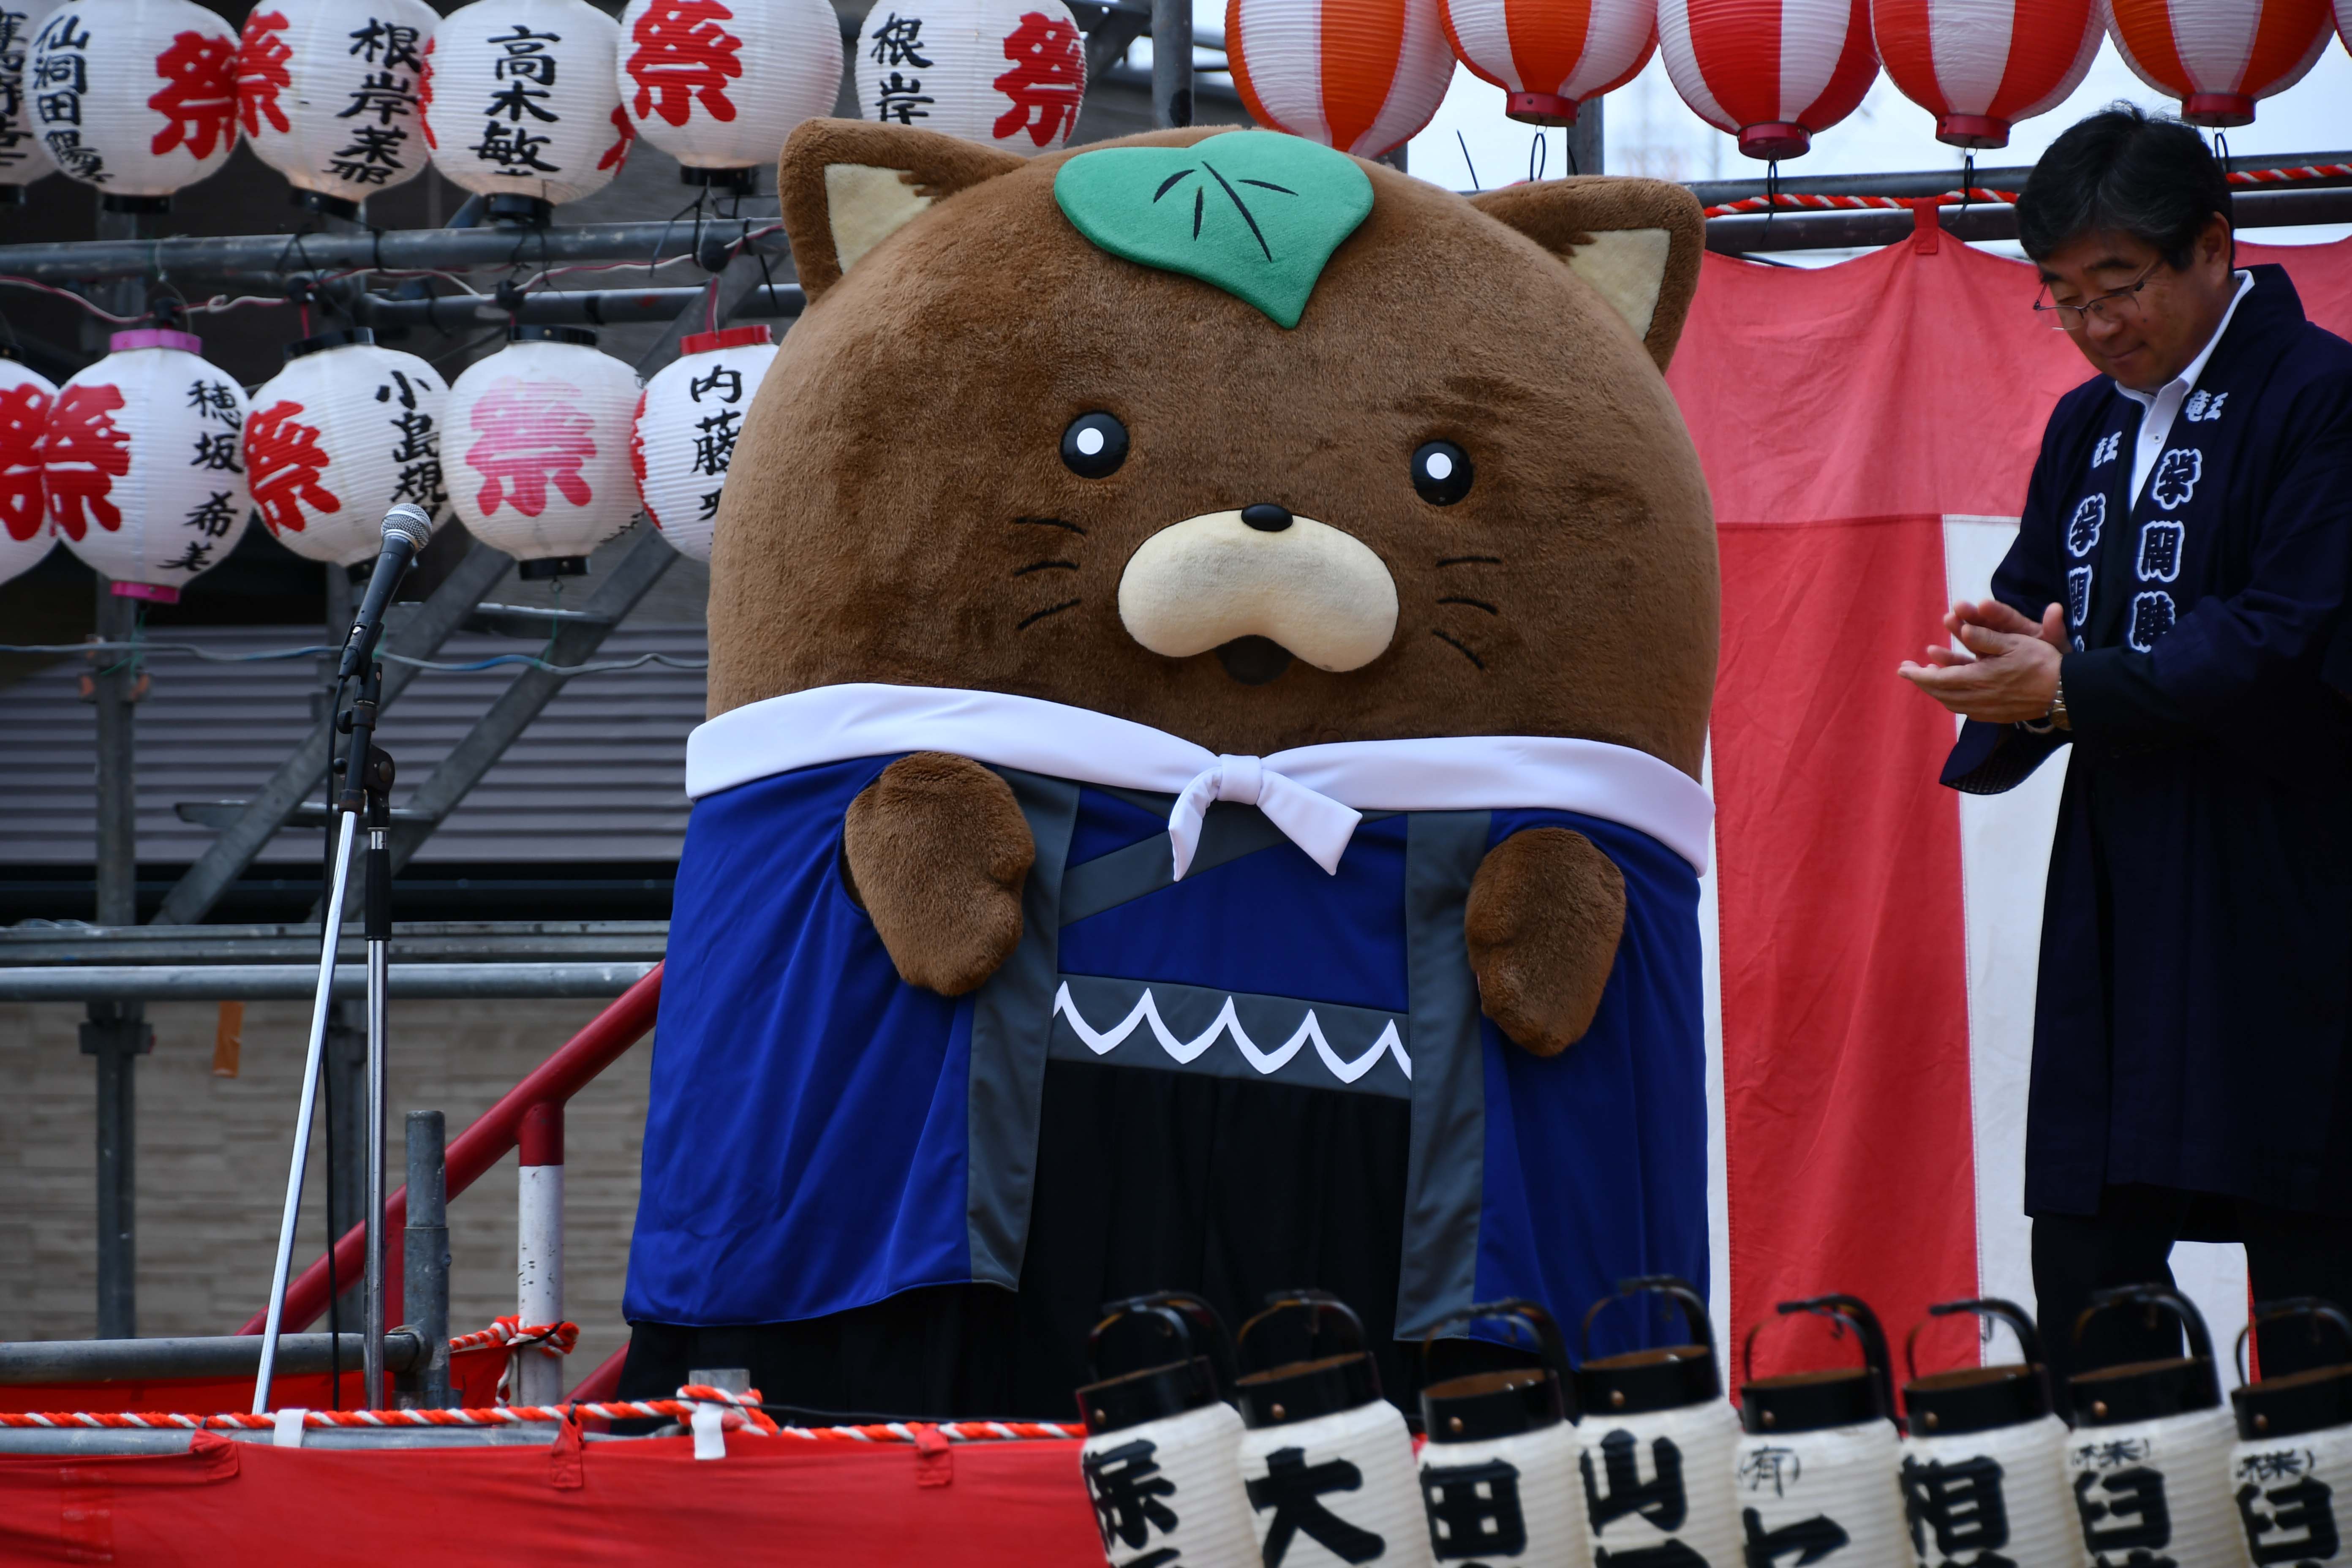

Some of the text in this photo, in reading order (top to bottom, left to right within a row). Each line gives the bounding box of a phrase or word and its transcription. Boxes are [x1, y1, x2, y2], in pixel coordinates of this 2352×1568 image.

[148, 30, 238, 160] 祭
[626, 0, 742, 126] 祭
[871, 12, 934, 125] 根岸
[993, 11, 1086, 147] 祭
[44, 384, 131, 542] 祭
[157, 379, 244, 572] 穂坂希美
[243, 400, 341, 537] 祭
[375, 370, 448, 524] 小島規
[465, 375, 597, 517] 祭
[1245, 1446, 1386, 1568] 大
[1419, 1457, 1528, 1568] 田
[1579, 1428, 1710, 1568] 山
[1898, 1454, 2019, 1568] 相
[2073, 1465, 2178, 1568] 臼
[2234, 1476, 2341, 1568] 臼
